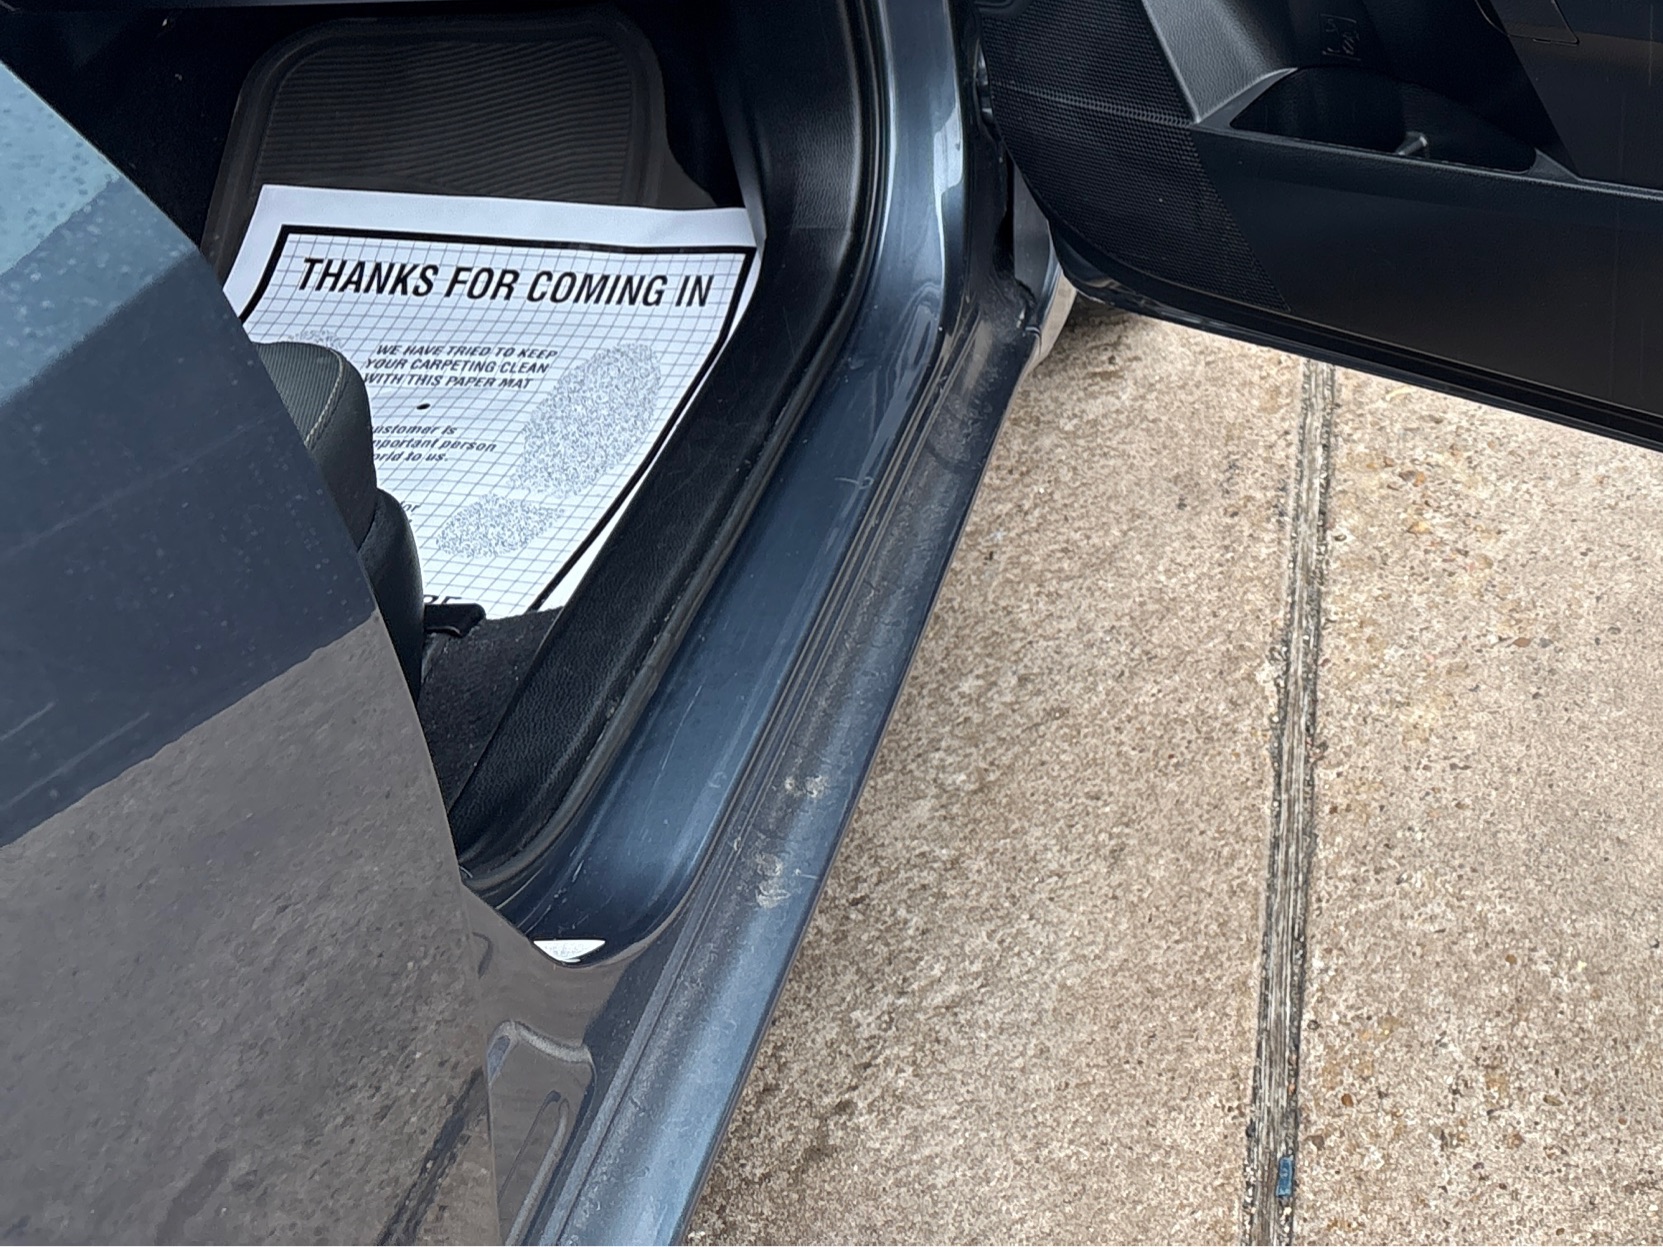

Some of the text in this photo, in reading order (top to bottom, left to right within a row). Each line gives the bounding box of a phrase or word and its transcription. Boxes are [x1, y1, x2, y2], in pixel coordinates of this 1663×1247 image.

[298, 257, 714, 308] THANKS FOR COMING IN
[377, 344, 558, 359] WE HAVE TRIED TO KEEP
[365, 358, 550, 374] YOUR CARPETING CLEAN
[364, 373, 534, 389] WITH THIS PAPER MAT
[371, 425, 458, 435] ustomer is
[372, 438, 497, 452] portant person
[373, 451, 448, 461] orld to us.
